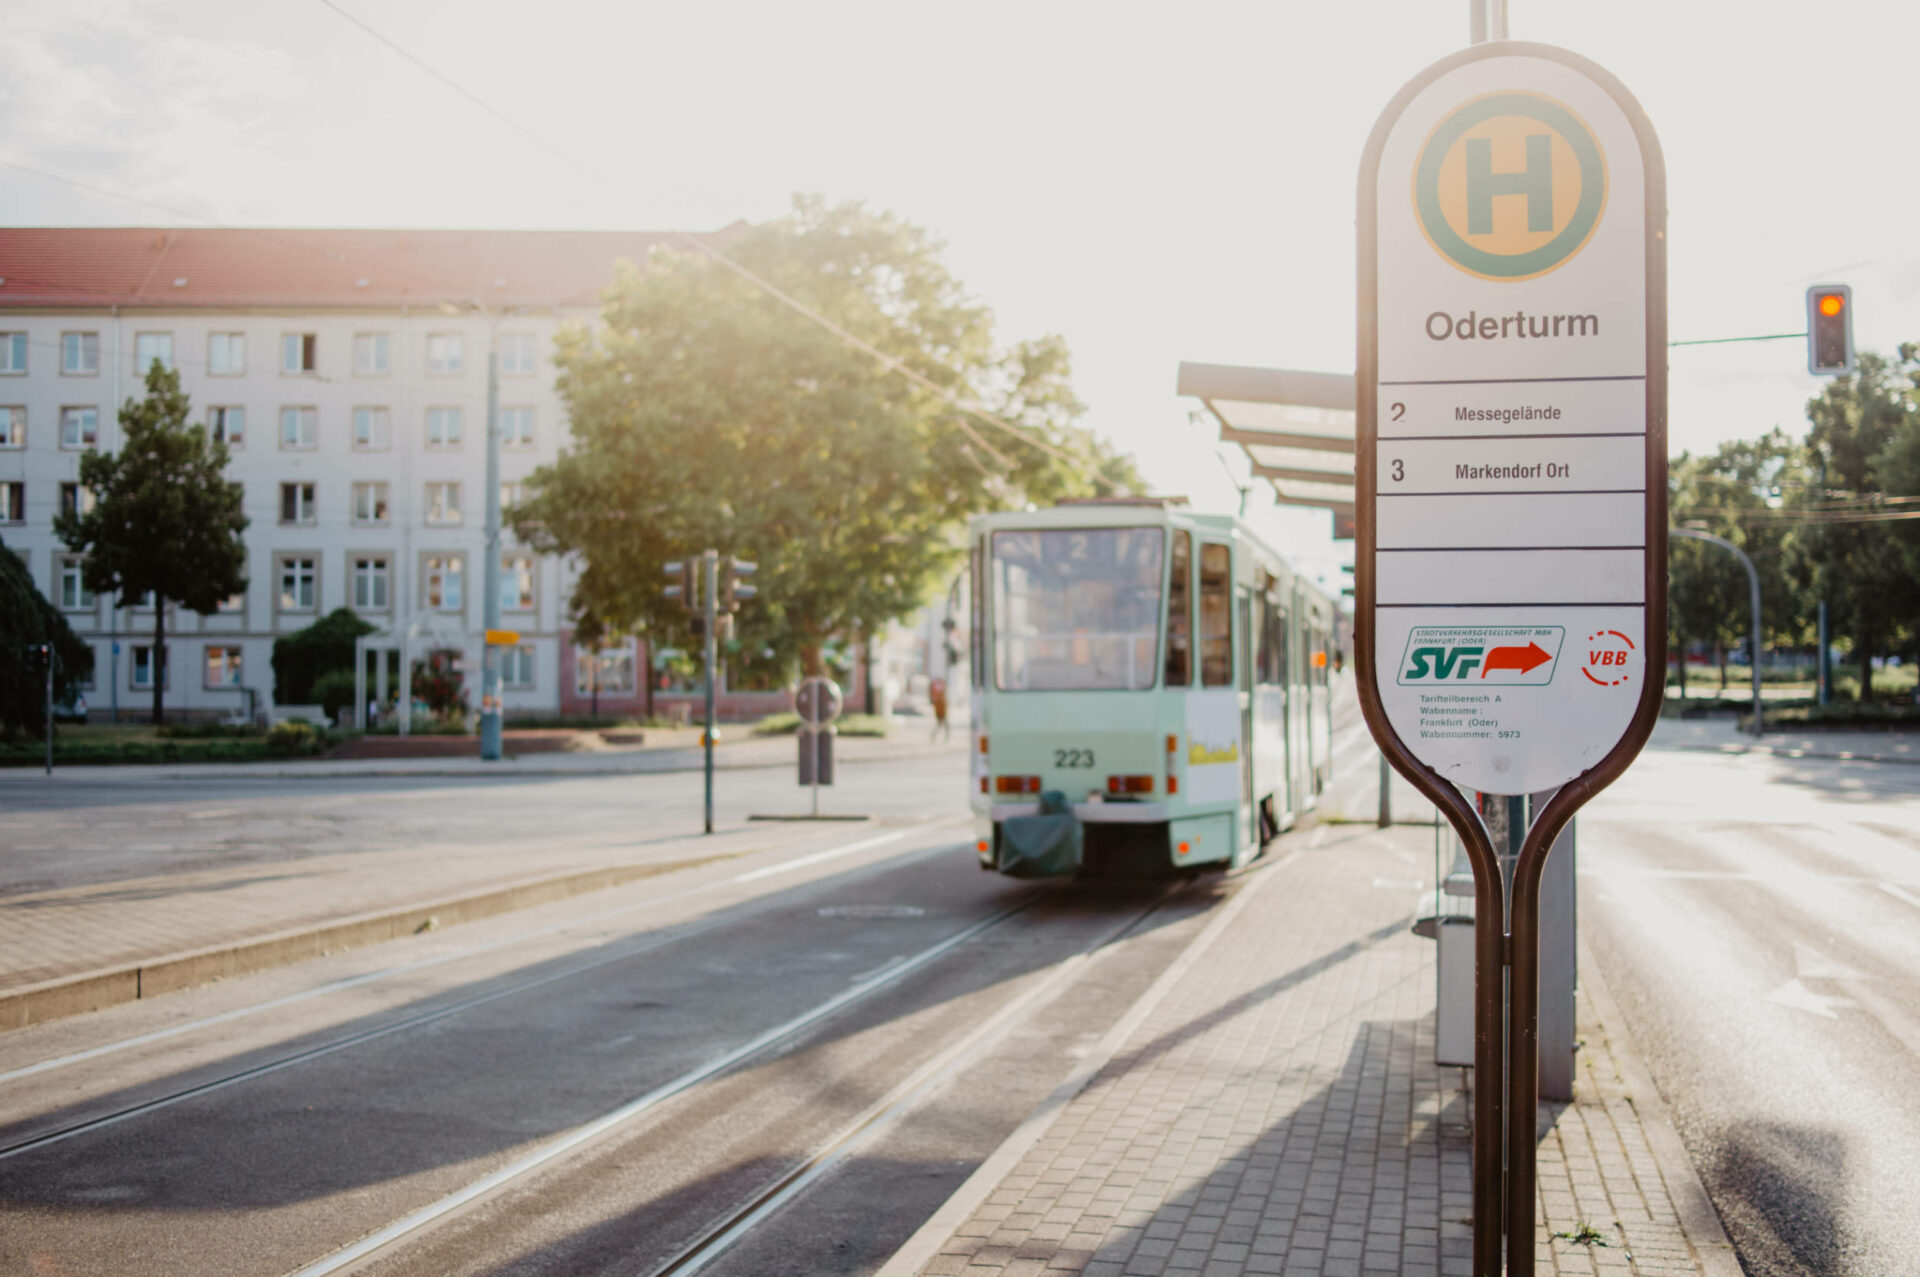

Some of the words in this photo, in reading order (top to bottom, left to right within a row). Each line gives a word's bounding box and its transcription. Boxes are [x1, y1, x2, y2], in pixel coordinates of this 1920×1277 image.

[1466, 134, 1553, 235] H
[1425, 311, 1599, 341] Oderturm
[1390, 402, 1406, 423] 2
[1455, 405, 1562, 424] Messegelände
[1391, 459, 1405, 482] 3
[1455, 463, 1542, 480] Markendorf
[1546, 462, 1570, 478] Ort
[1405, 647, 1484, 679] SVF
[1589, 650, 1628, 666] VBB
[1420, 695, 1490, 703] Tarifteilbereich
[1494, 695, 1502, 703] A
[1420, 719, 1463, 727] Frankfurt
[1467, 719, 1498, 728] (Oder)
[1420, 730, 1493, 738] Wabennummer:
[1498, 730, 1521, 738] 5973
[1054, 749, 1095, 769] 223
